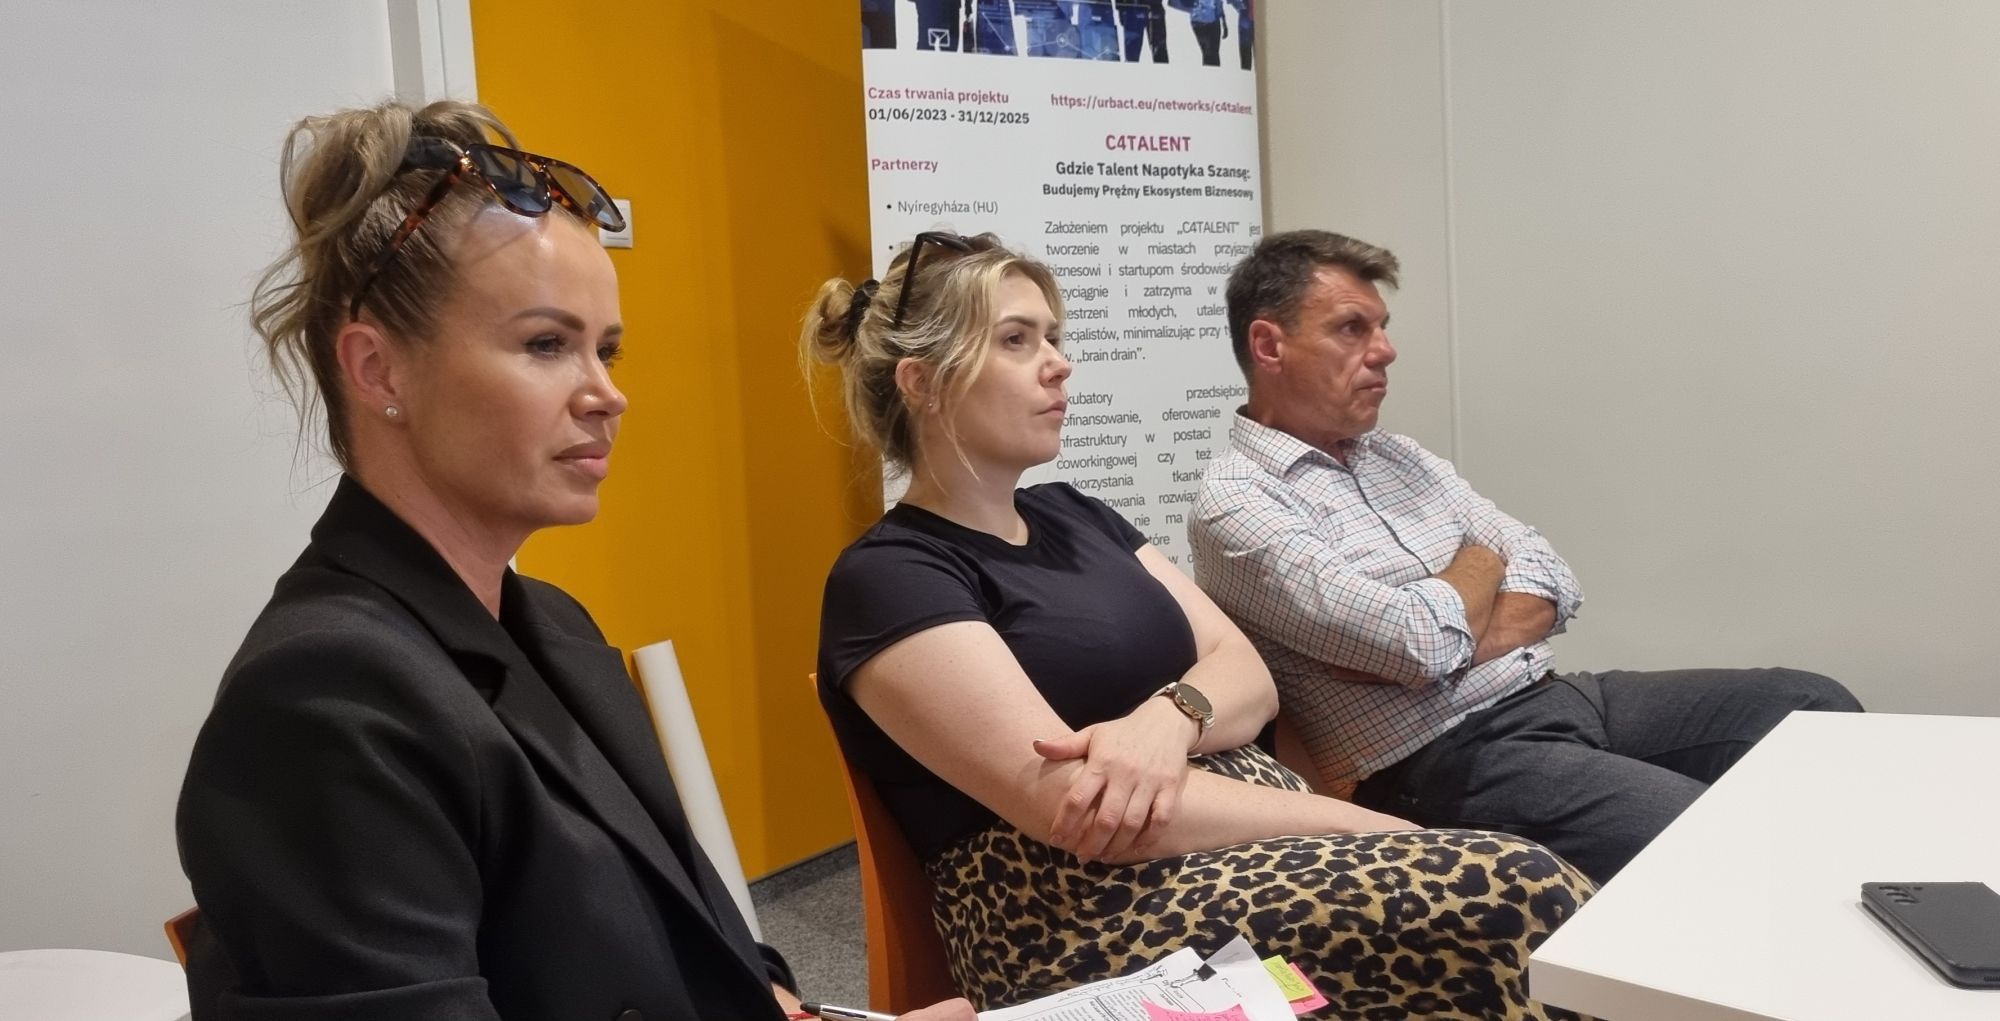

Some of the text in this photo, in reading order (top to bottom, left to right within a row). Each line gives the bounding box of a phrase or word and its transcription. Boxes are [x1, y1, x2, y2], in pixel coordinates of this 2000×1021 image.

[868, 87, 1009, 105] Czas trwania projektu
[869, 108, 947, 122] 01/06/2023
[958, 110, 1030, 125] 31/12/2025
[1105, 134, 1191, 151] C4TALENT
[871, 158, 938, 173] Partnerzy
[1056, 161, 1251, 181] Gdzie Talent Napotyka Szansę:
[1042, 183, 1254, 201] Budujemy Prężny Ekosystem Biznesowy
[898, 201, 998, 215] Nyíregyháza (HU)
[1045, 221, 1108, 234] Założeniem
[1120, 221, 1164, 237] projektu
[1046, 244, 1100, 256] tworzenie
[1119, 246, 1128, 255] w
[1148, 242, 1196, 255] miastach
[1108, 264, 1112, 276] i
[1118, 264, 1174, 277] startupom
[1181, 262, 1232, 275] środowisk
[1060, 284, 1218, 301] zyciągnie i zatrzyma w
[1066, 304, 1229, 320] estrzeni młodych, utalen
[1065, 327, 1119, 344] ecjalistów,
[1123, 325, 1196, 341] minimalizując
[1199, 326, 1221, 339] przy
[1077, 348, 1109, 363] „brain
[1067, 384, 1248, 406] kubatory przedsiębior
[1063, 406, 1221, 427] ofinansowanie, oferowanie
[1060, 427, 1211, 448] nfrastruktury w postaci
[1056, 447, 1212, 470] coworkingowej czy też
[1172, 467, 1204, 482] tkanki
[1104, 489, 1200, 508] towania rozwiąz
[1135, 513, 1183, 527] nie ma
[1149, 533, 1170, 546] tóre
